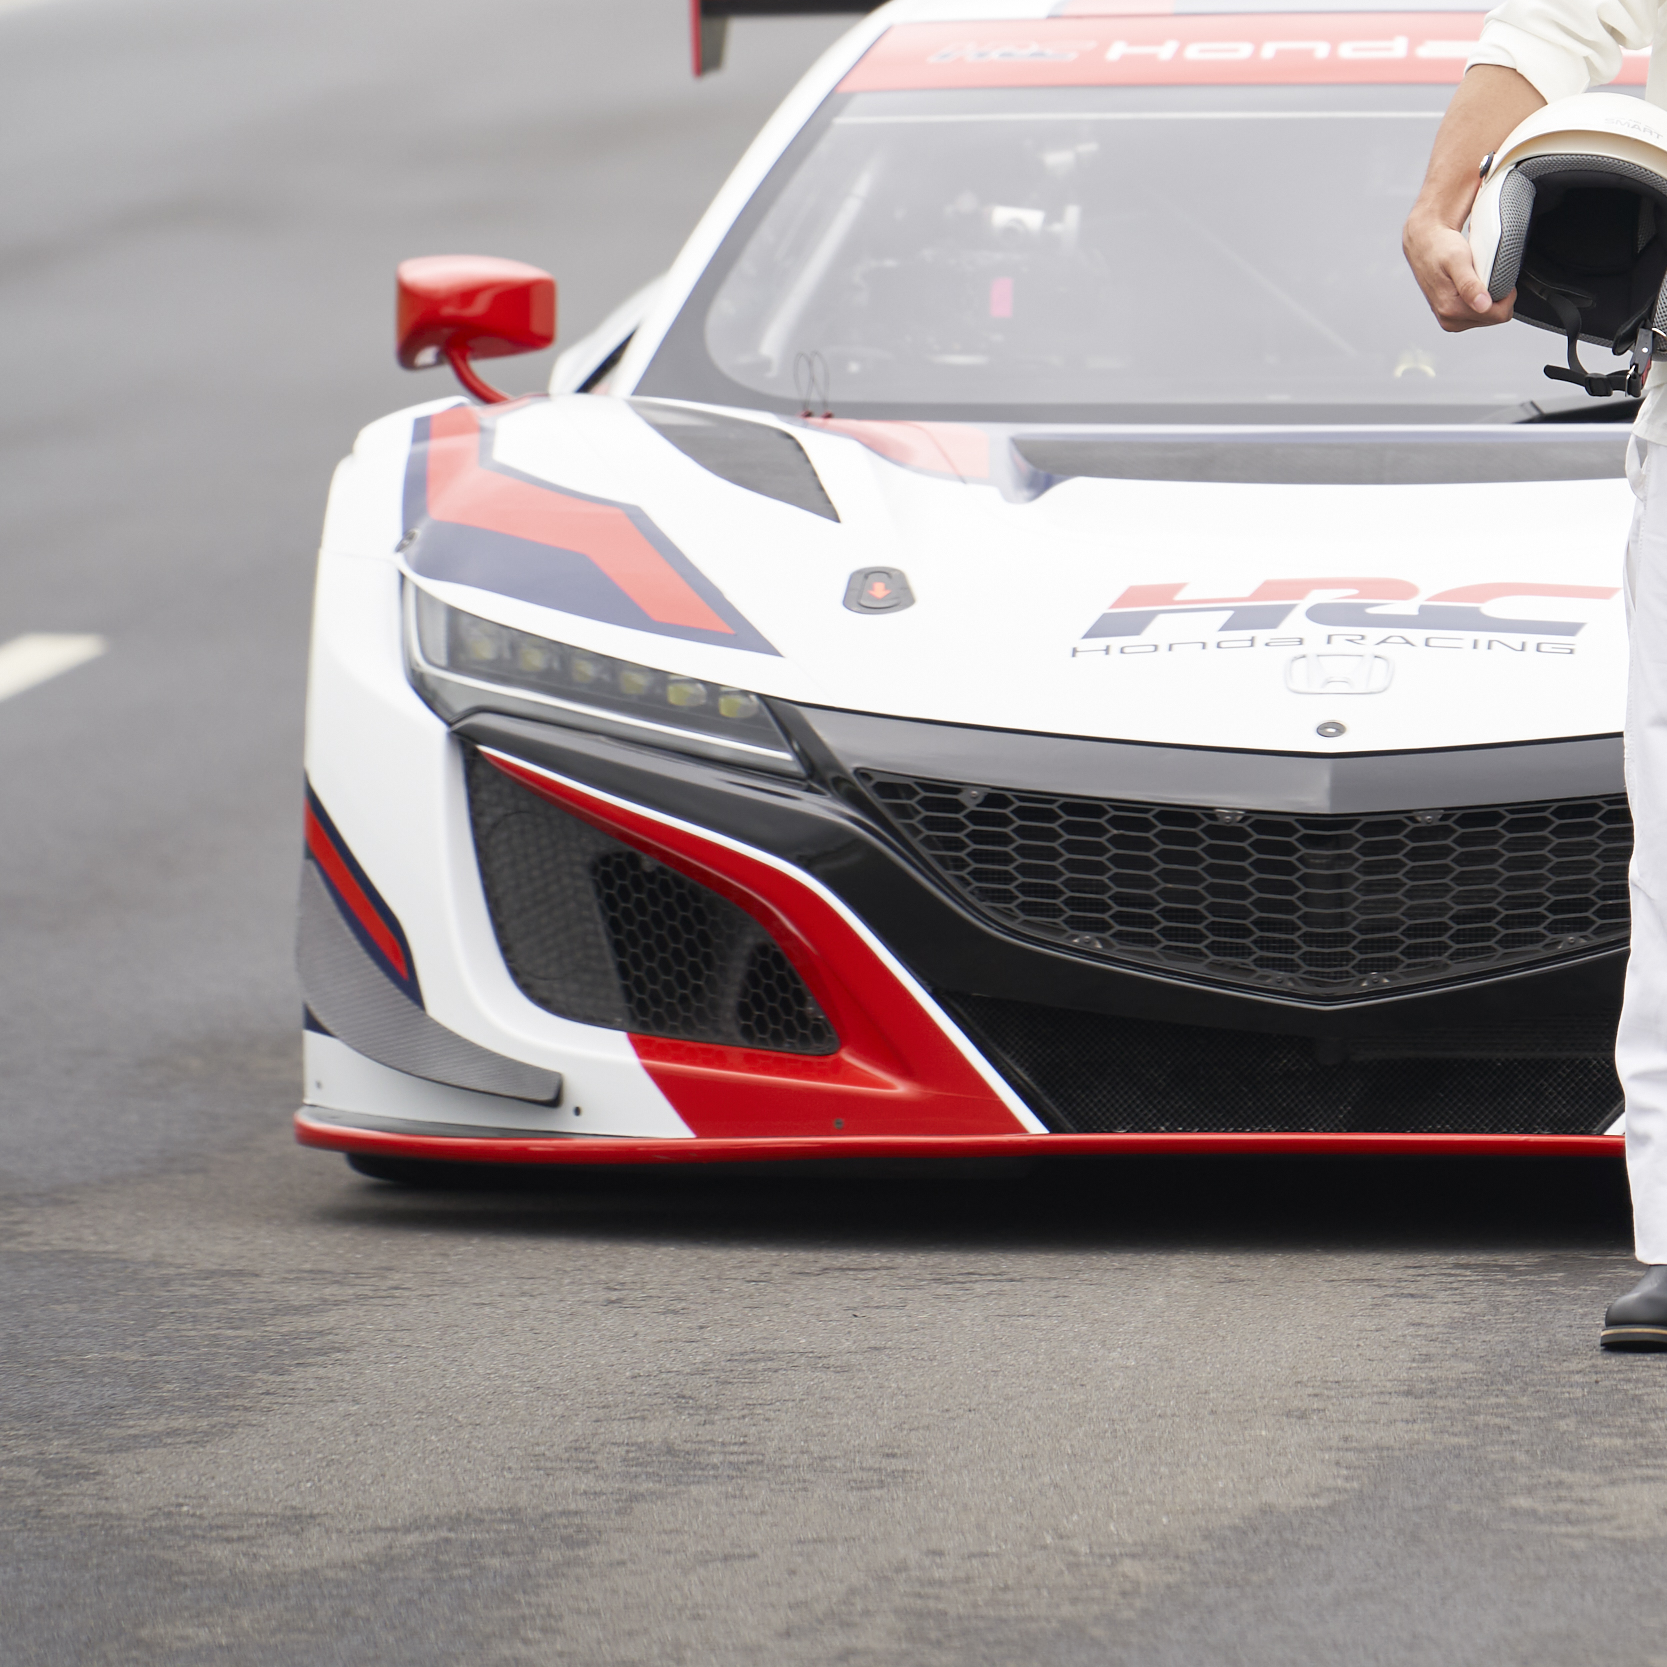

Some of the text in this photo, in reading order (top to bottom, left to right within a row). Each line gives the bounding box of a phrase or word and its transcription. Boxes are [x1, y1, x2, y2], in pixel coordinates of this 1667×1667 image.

[1604, 118, 1664, 139] SMART
[1081, 577, 1622, 639] HRC
[1071, 632, 1576, 658] Honda RACING
